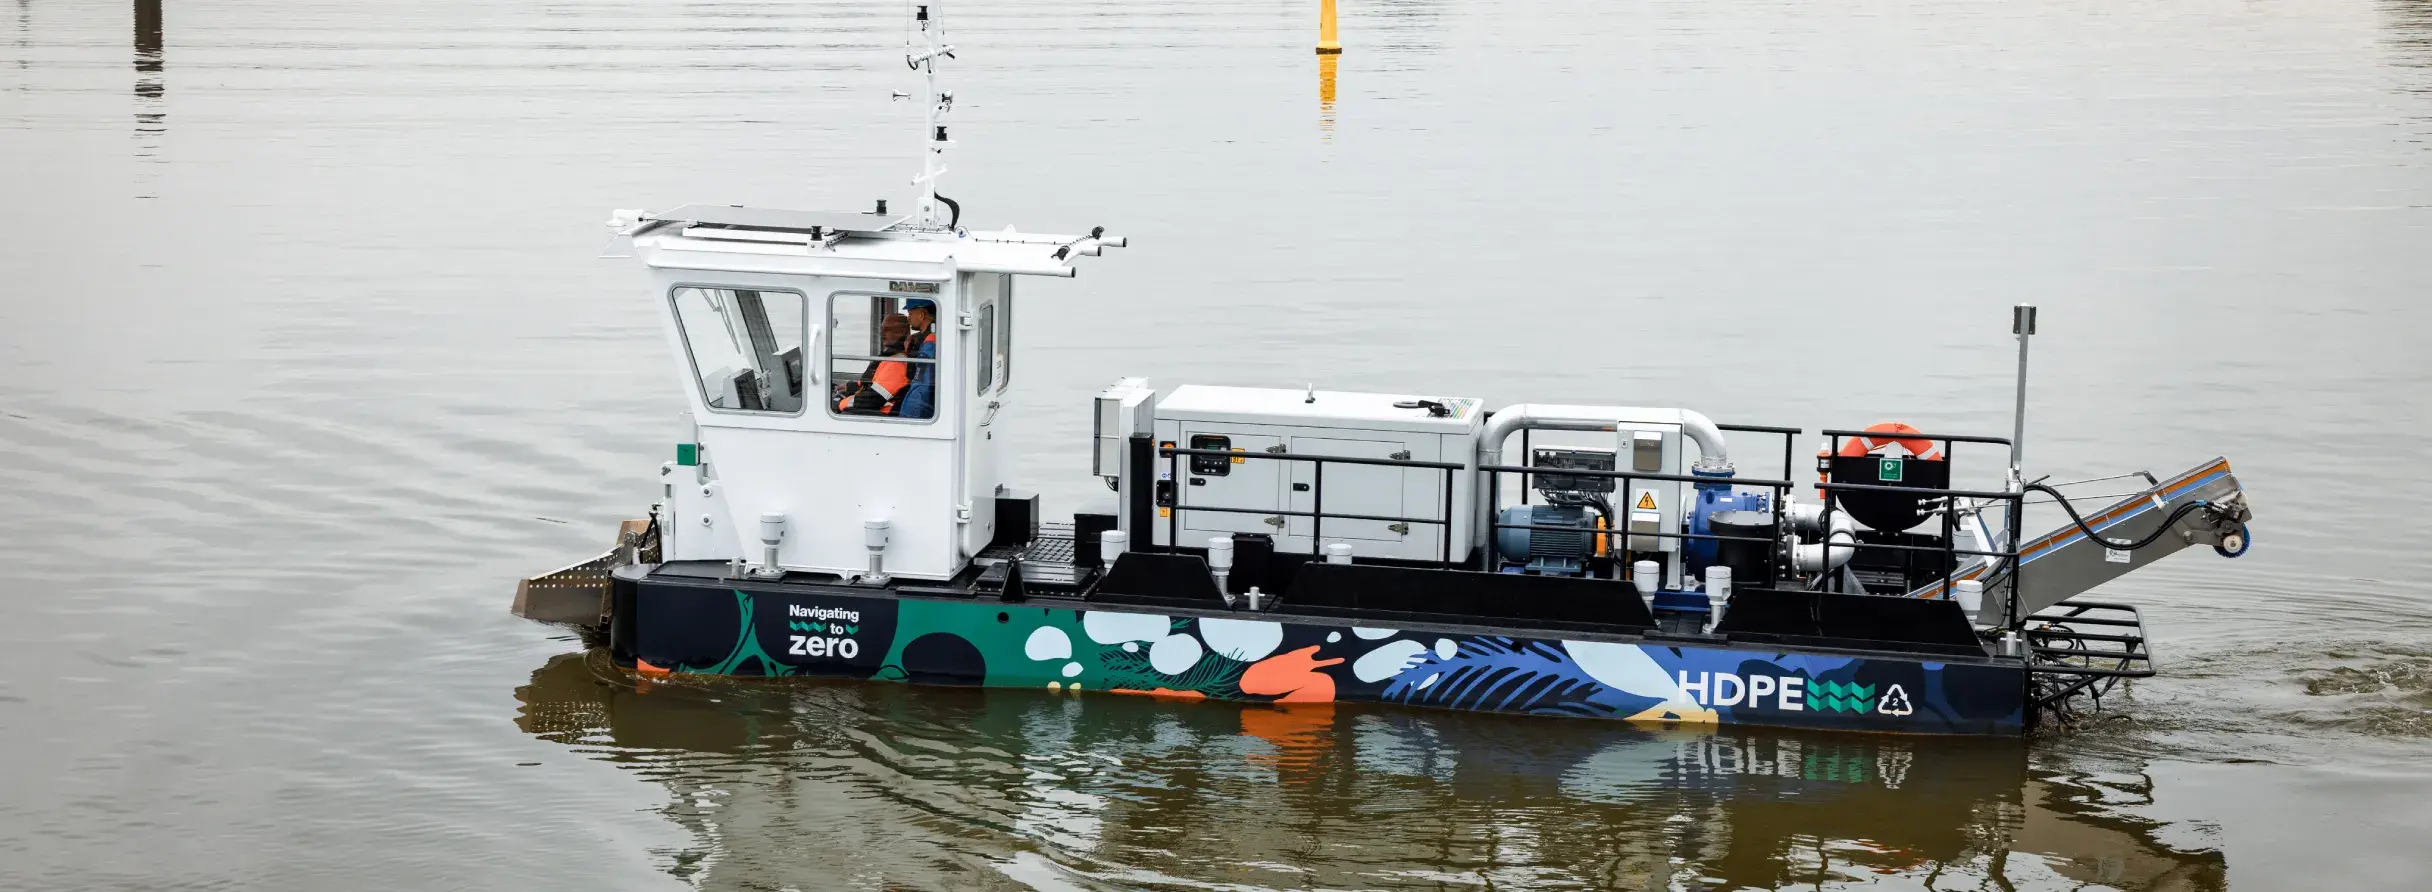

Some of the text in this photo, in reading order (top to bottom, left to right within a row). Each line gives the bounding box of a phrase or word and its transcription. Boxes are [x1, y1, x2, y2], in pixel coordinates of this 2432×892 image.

[789, 604, 860, 623] Navigating
[829, 622, 845, 635] to
[788, 635, 859, 659] zero
[1678, 669, 1804, 711] HDPE
[1892, 697, 1899, 706] 2
